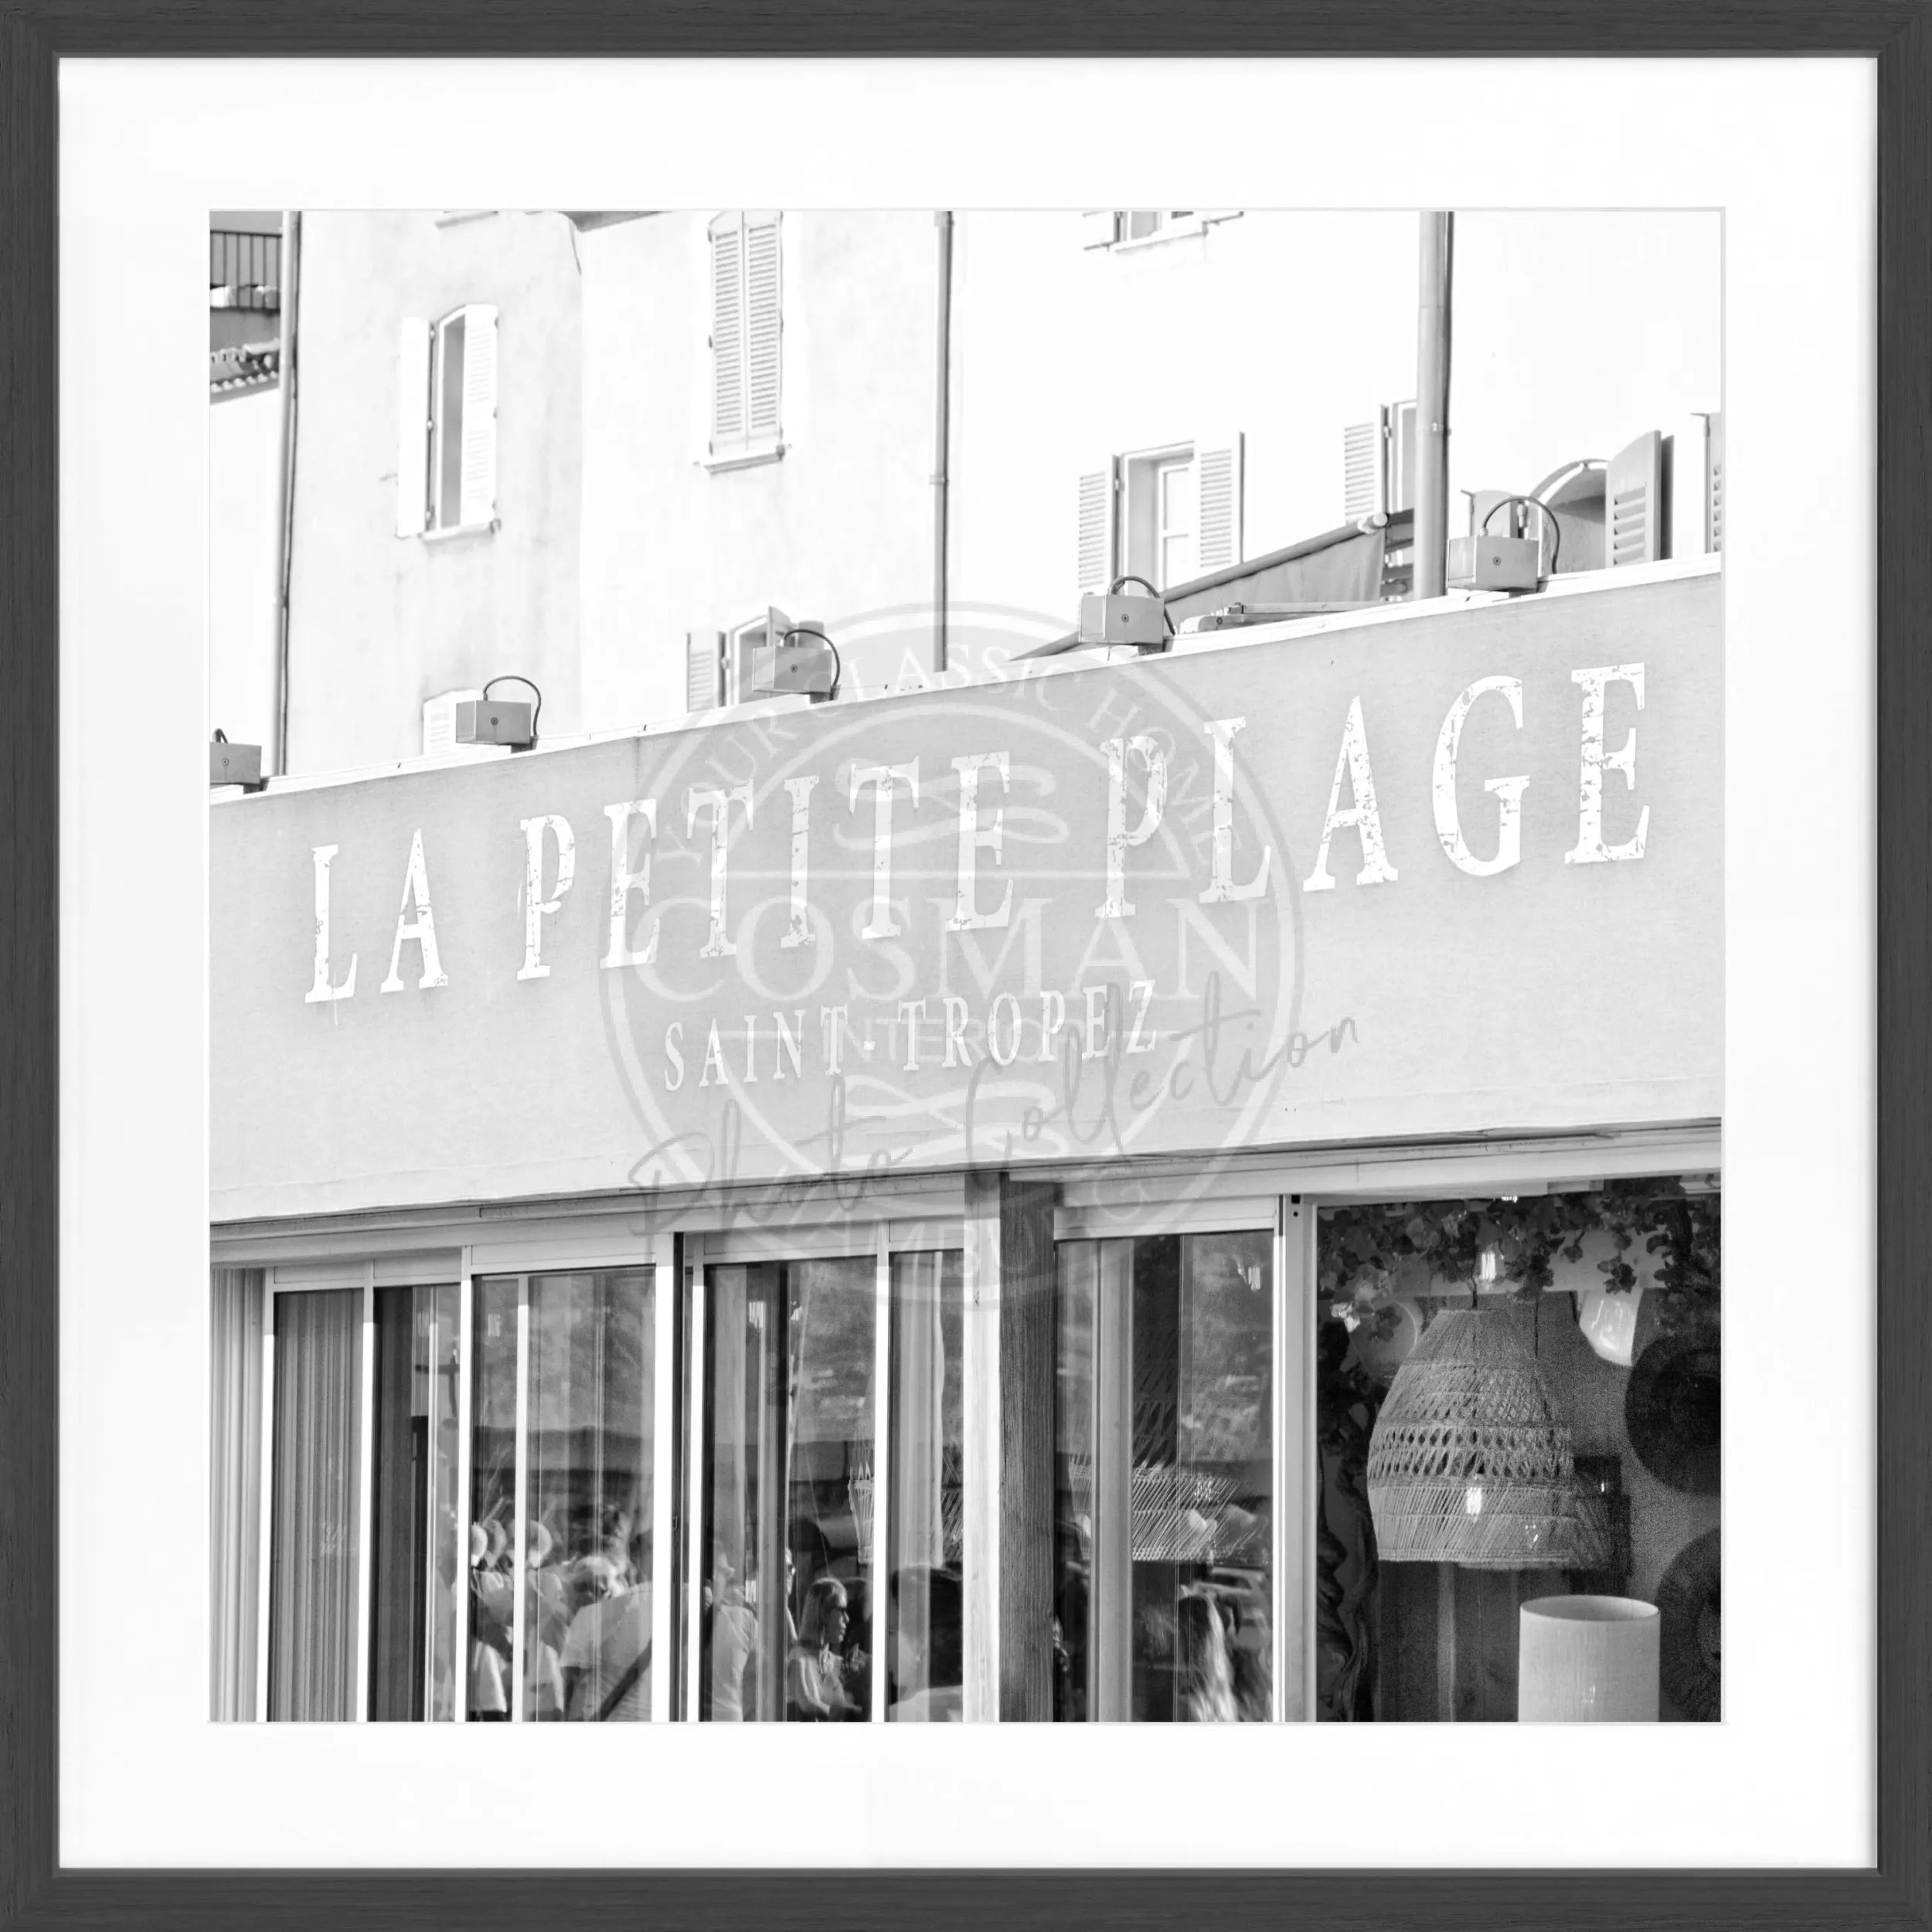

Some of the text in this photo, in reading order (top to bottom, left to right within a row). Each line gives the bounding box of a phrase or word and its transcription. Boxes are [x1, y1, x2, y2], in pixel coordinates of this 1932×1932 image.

[304, 662, 1651, 1003] LA PETITE PLAGE
